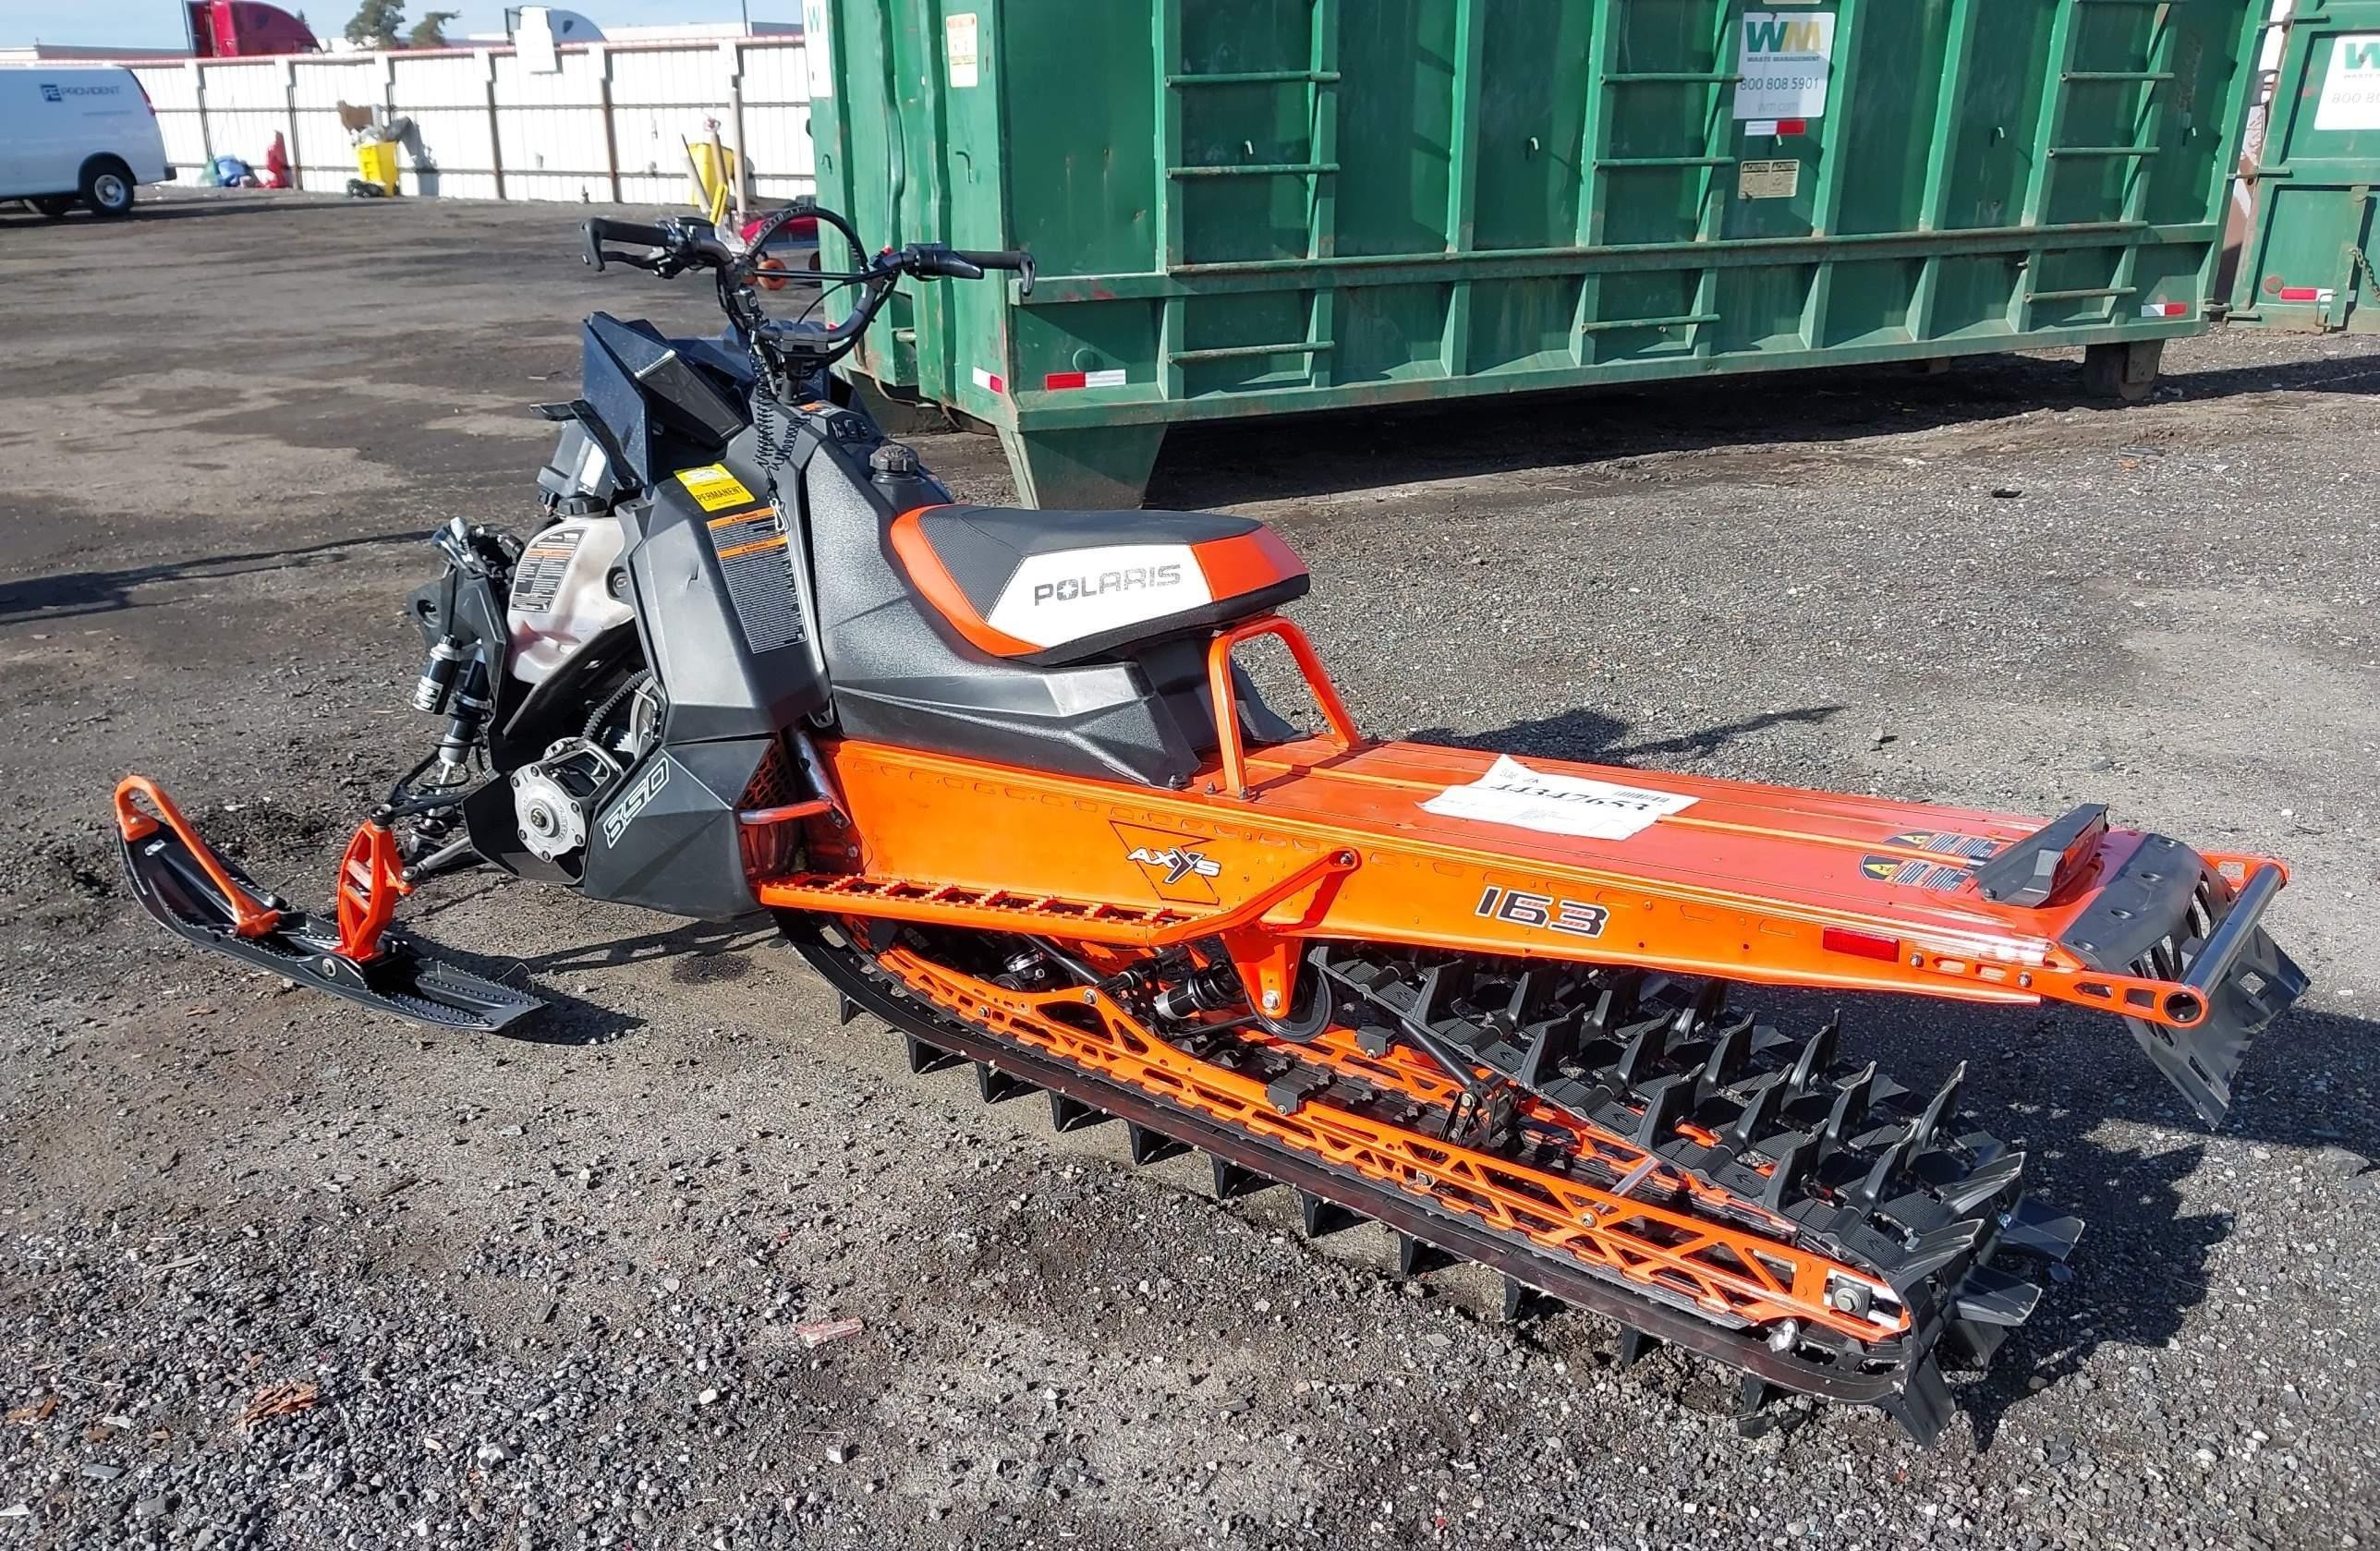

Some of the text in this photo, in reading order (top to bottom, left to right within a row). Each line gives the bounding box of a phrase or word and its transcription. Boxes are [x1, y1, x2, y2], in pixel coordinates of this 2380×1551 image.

[1745, 21, 1821, 53] WM
[60, 85, 121, 95] PROVIDENT
[1740, 77, 1819, 91] 800 808 5901
[2331, 92, 2362, 103] 800
[694, 485, 746, 503] PERMANENT
[1034, 563, 1182, 607] POLARIS
[602, 757, 670, 850] 850
[1125, 846, 1222, 885] AXYS
[1475, 884, 1611, 939] 163
